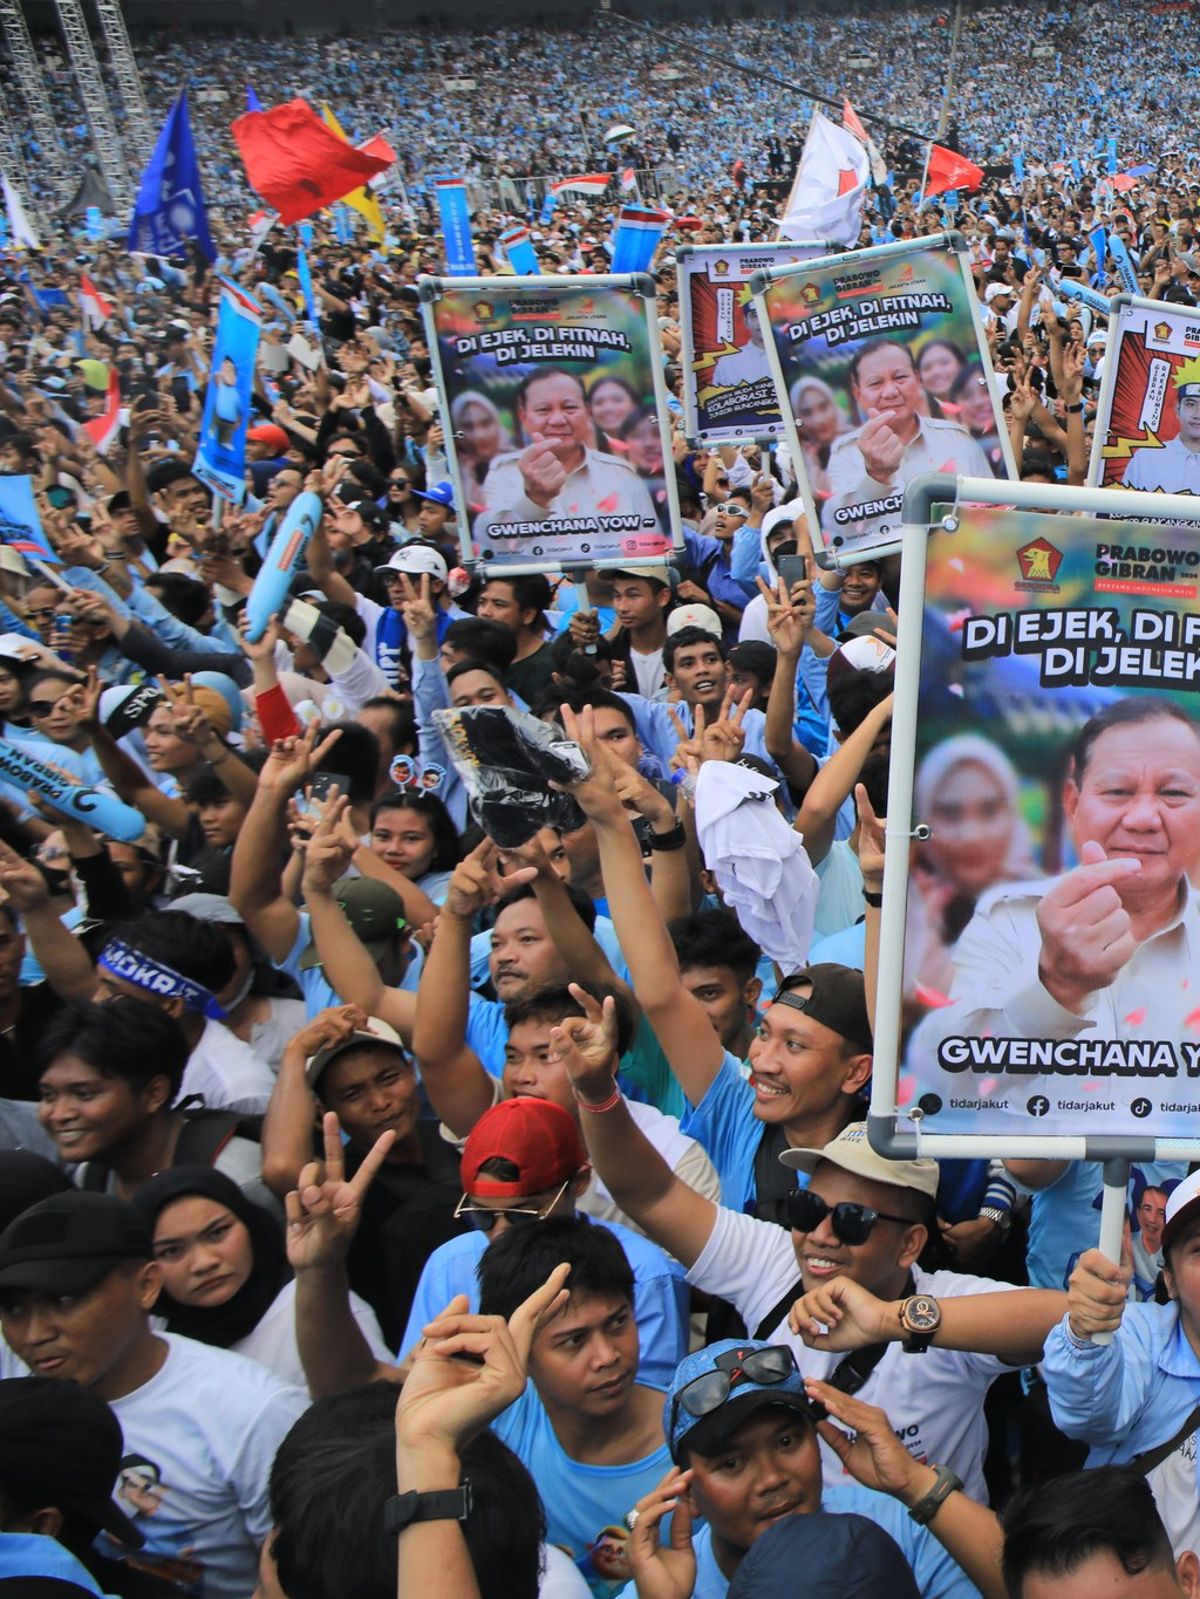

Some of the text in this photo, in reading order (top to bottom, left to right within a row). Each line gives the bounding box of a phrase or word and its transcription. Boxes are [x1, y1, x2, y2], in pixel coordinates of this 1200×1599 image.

[833, 270, 880, 285] PRABOWO
[790, 294, 951, 341] DI EJEK, DI FITNAH,
[826, 312, 919, 343] DI JELEKIN
[457, 327, 631, 353] DI EJEK, DI FITNAH,
[496, 344, 596, 362] DI JELEKIN
[708, 390, 767, 413] KOLABORASI
[487, 517, 596, 537] GWENCHANA
[599, 514, 641, 528] YOW
[1096, 543, 1200, 567] PRABOWO
[1094, 560, 1175, 582] GIBRAN
[966, 616, 1007, 650] DI
[1018, 611, 1123, 644] EJEK,
[1134, 612, 1174, 643] DI
[1044, 647, 1086, 677] DI
[941, 1038, 1174, 1069] GWENCHANA
[950, 1097, 1009, 1111] tidarjakut
[1057, 1099, 1116, 1113] tidarjakut
